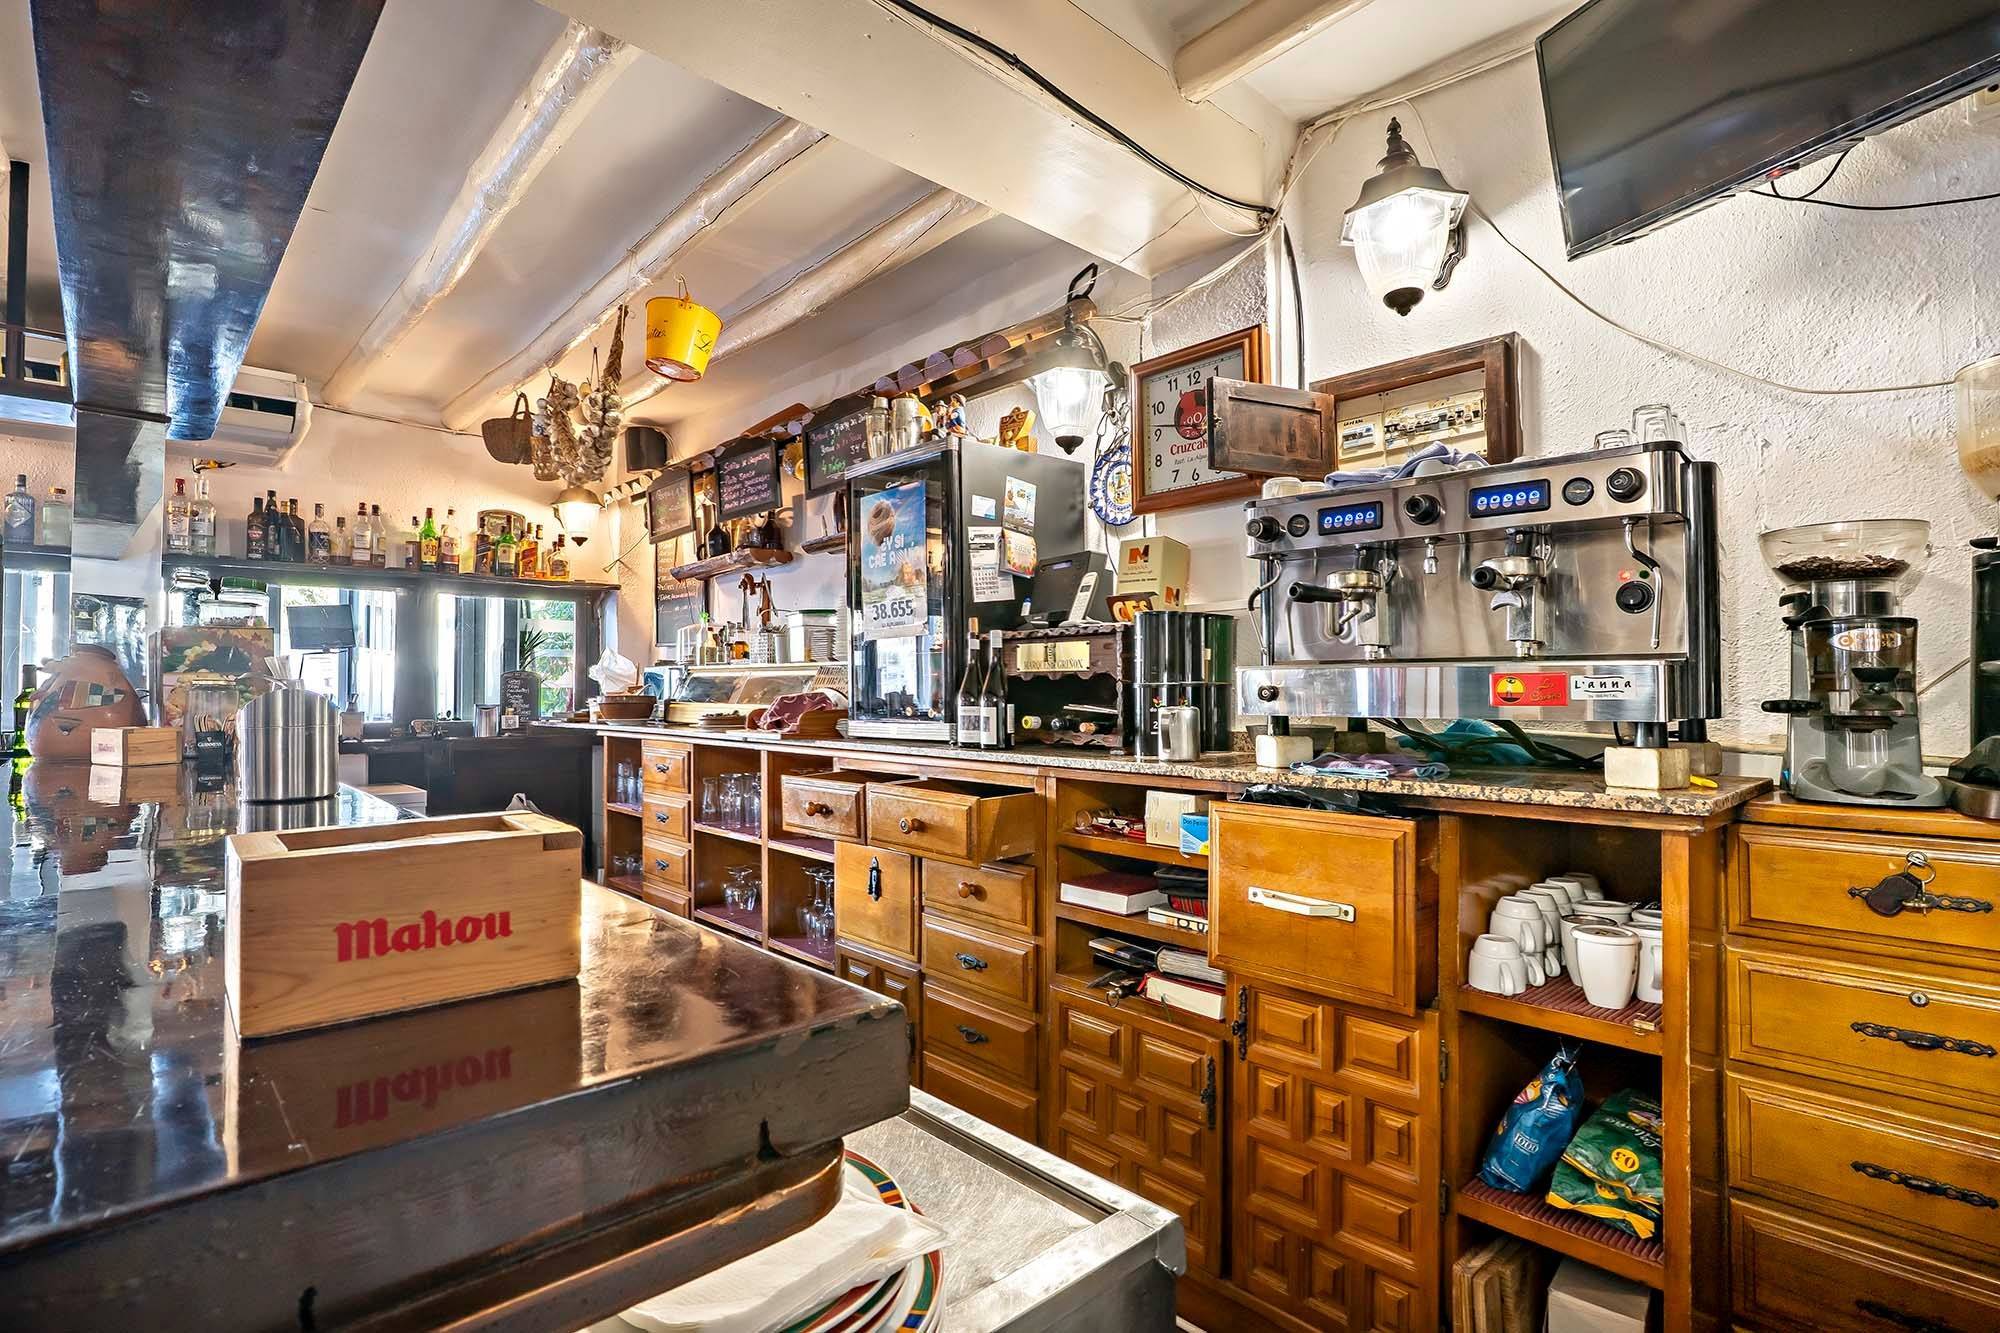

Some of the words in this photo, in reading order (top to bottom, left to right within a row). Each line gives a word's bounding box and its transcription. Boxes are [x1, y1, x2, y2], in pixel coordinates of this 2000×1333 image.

[1168, 377, 1178, 392] 11
[1187, 371, 1201, 386] 12
[1152, 401, 1165, 415] 10
[1154, 429, 1162, 442] 9
[1155, 454, 1163, 468] 8
[1172, 470, 1179, 483] 7
[1192, 468, 1200, 481] 6
[868, 553, 887, 569] CAE
[872, 599, 914, 621] 38.655
[1575, 680, 1632, 689] L'anna
[335, 910, 512, 962] Mahou
